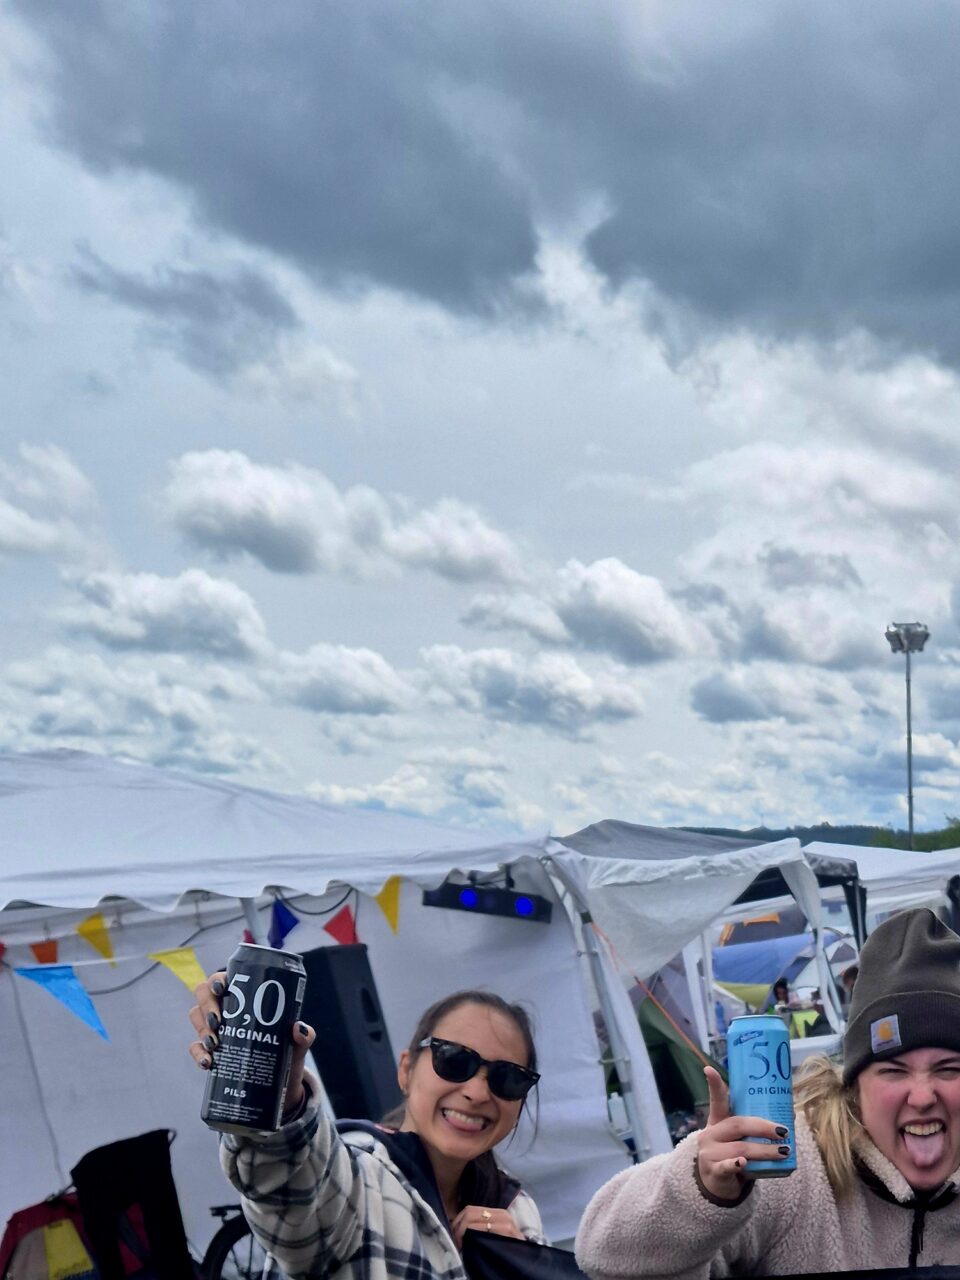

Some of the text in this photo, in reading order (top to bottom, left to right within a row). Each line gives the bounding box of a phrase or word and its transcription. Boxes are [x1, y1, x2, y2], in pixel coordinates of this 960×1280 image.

[223, 974, 286, 1027] 5,0
[749, 1041, 791, 1083] 5,0
[224, 1087, 247, 1098] PILS
